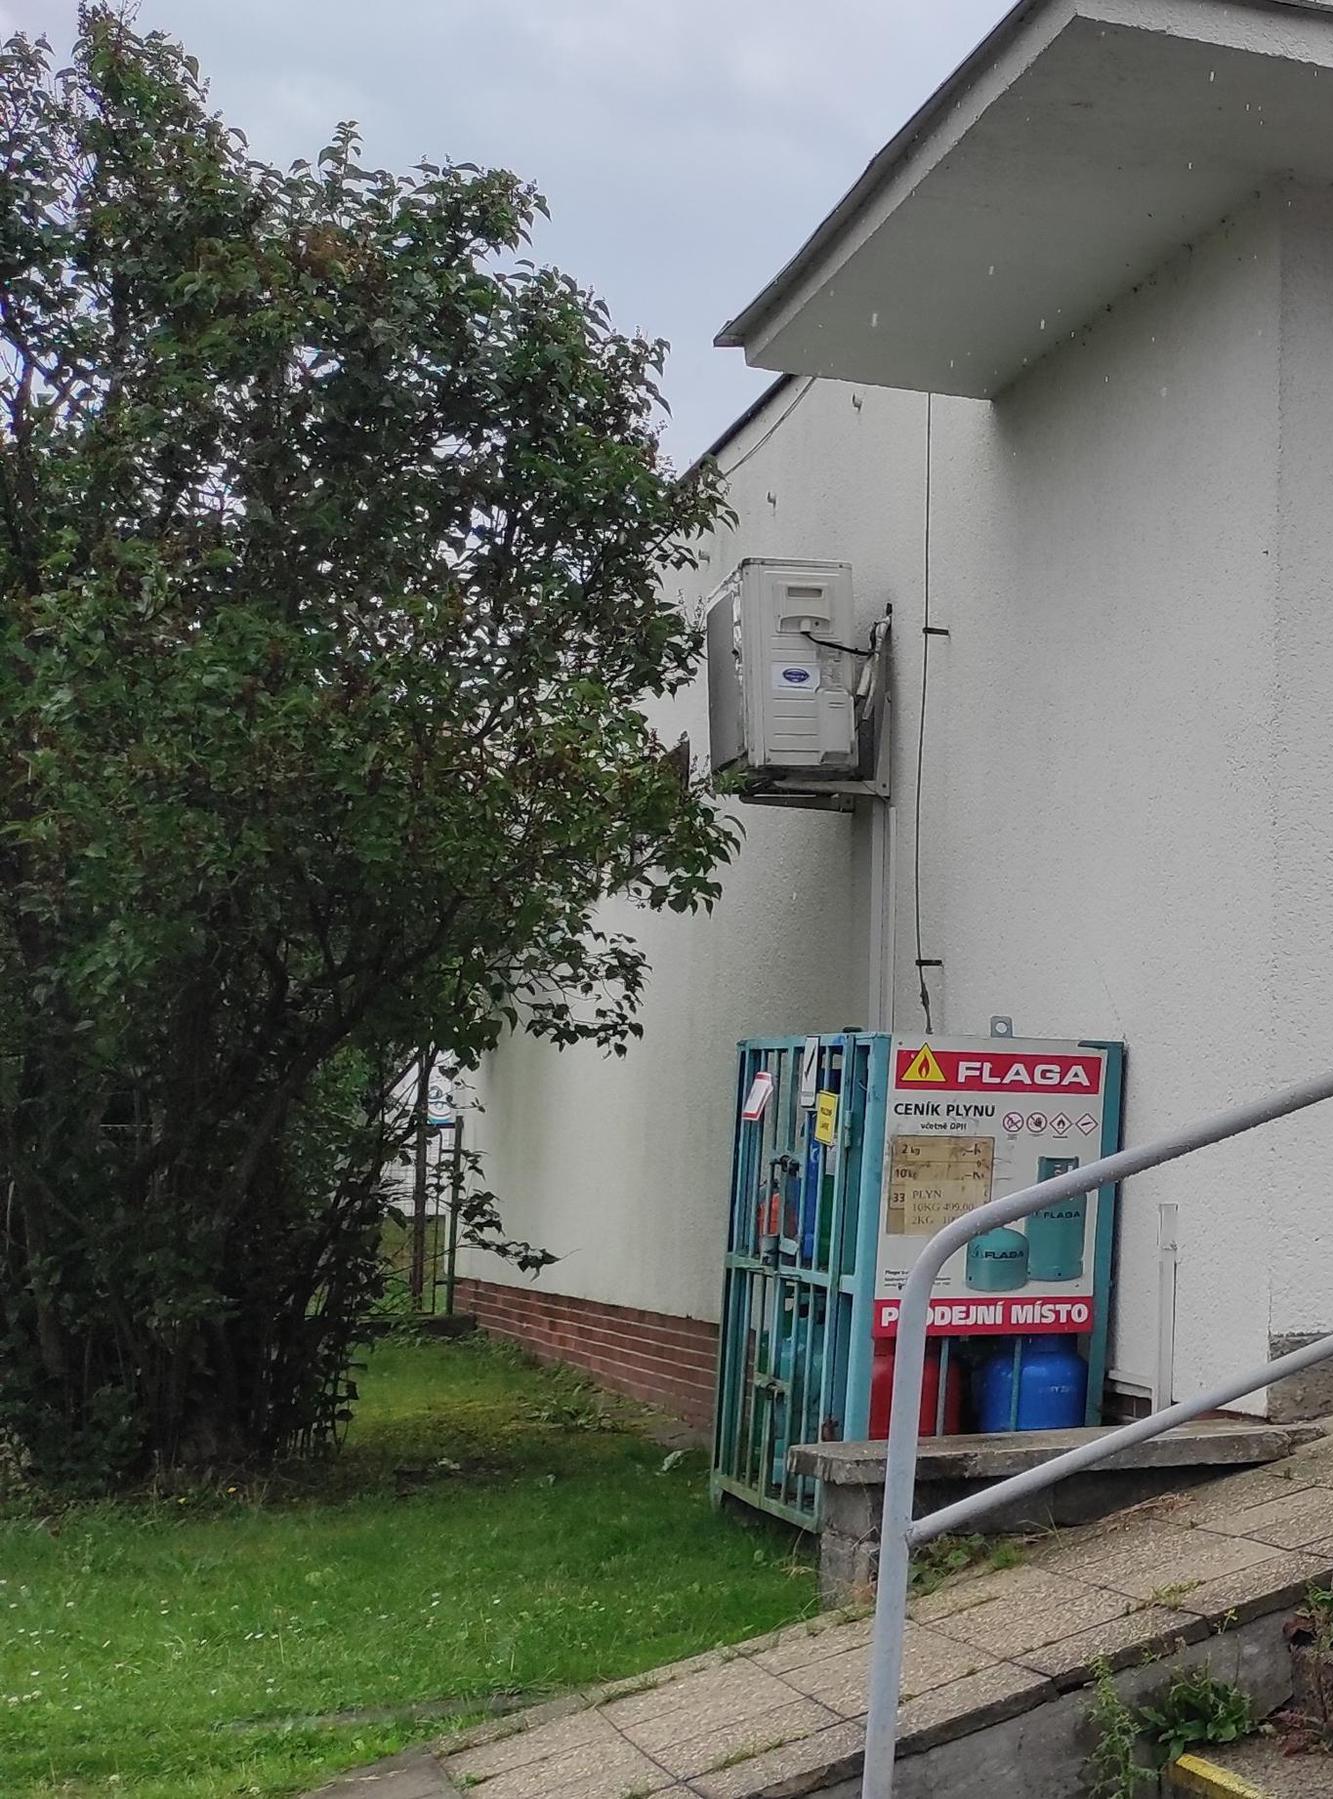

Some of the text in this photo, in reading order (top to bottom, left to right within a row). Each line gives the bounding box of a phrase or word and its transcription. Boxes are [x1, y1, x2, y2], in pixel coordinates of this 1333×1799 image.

[957, 1061, 1091, 1087] FLAGA
[894, 1101, 995, 1117] CENÍK PLYNU
[912, 1190, 942, 1199] PLYN
[881, 1300, 1089, 1327] PDEJNÍ MÍSTO
